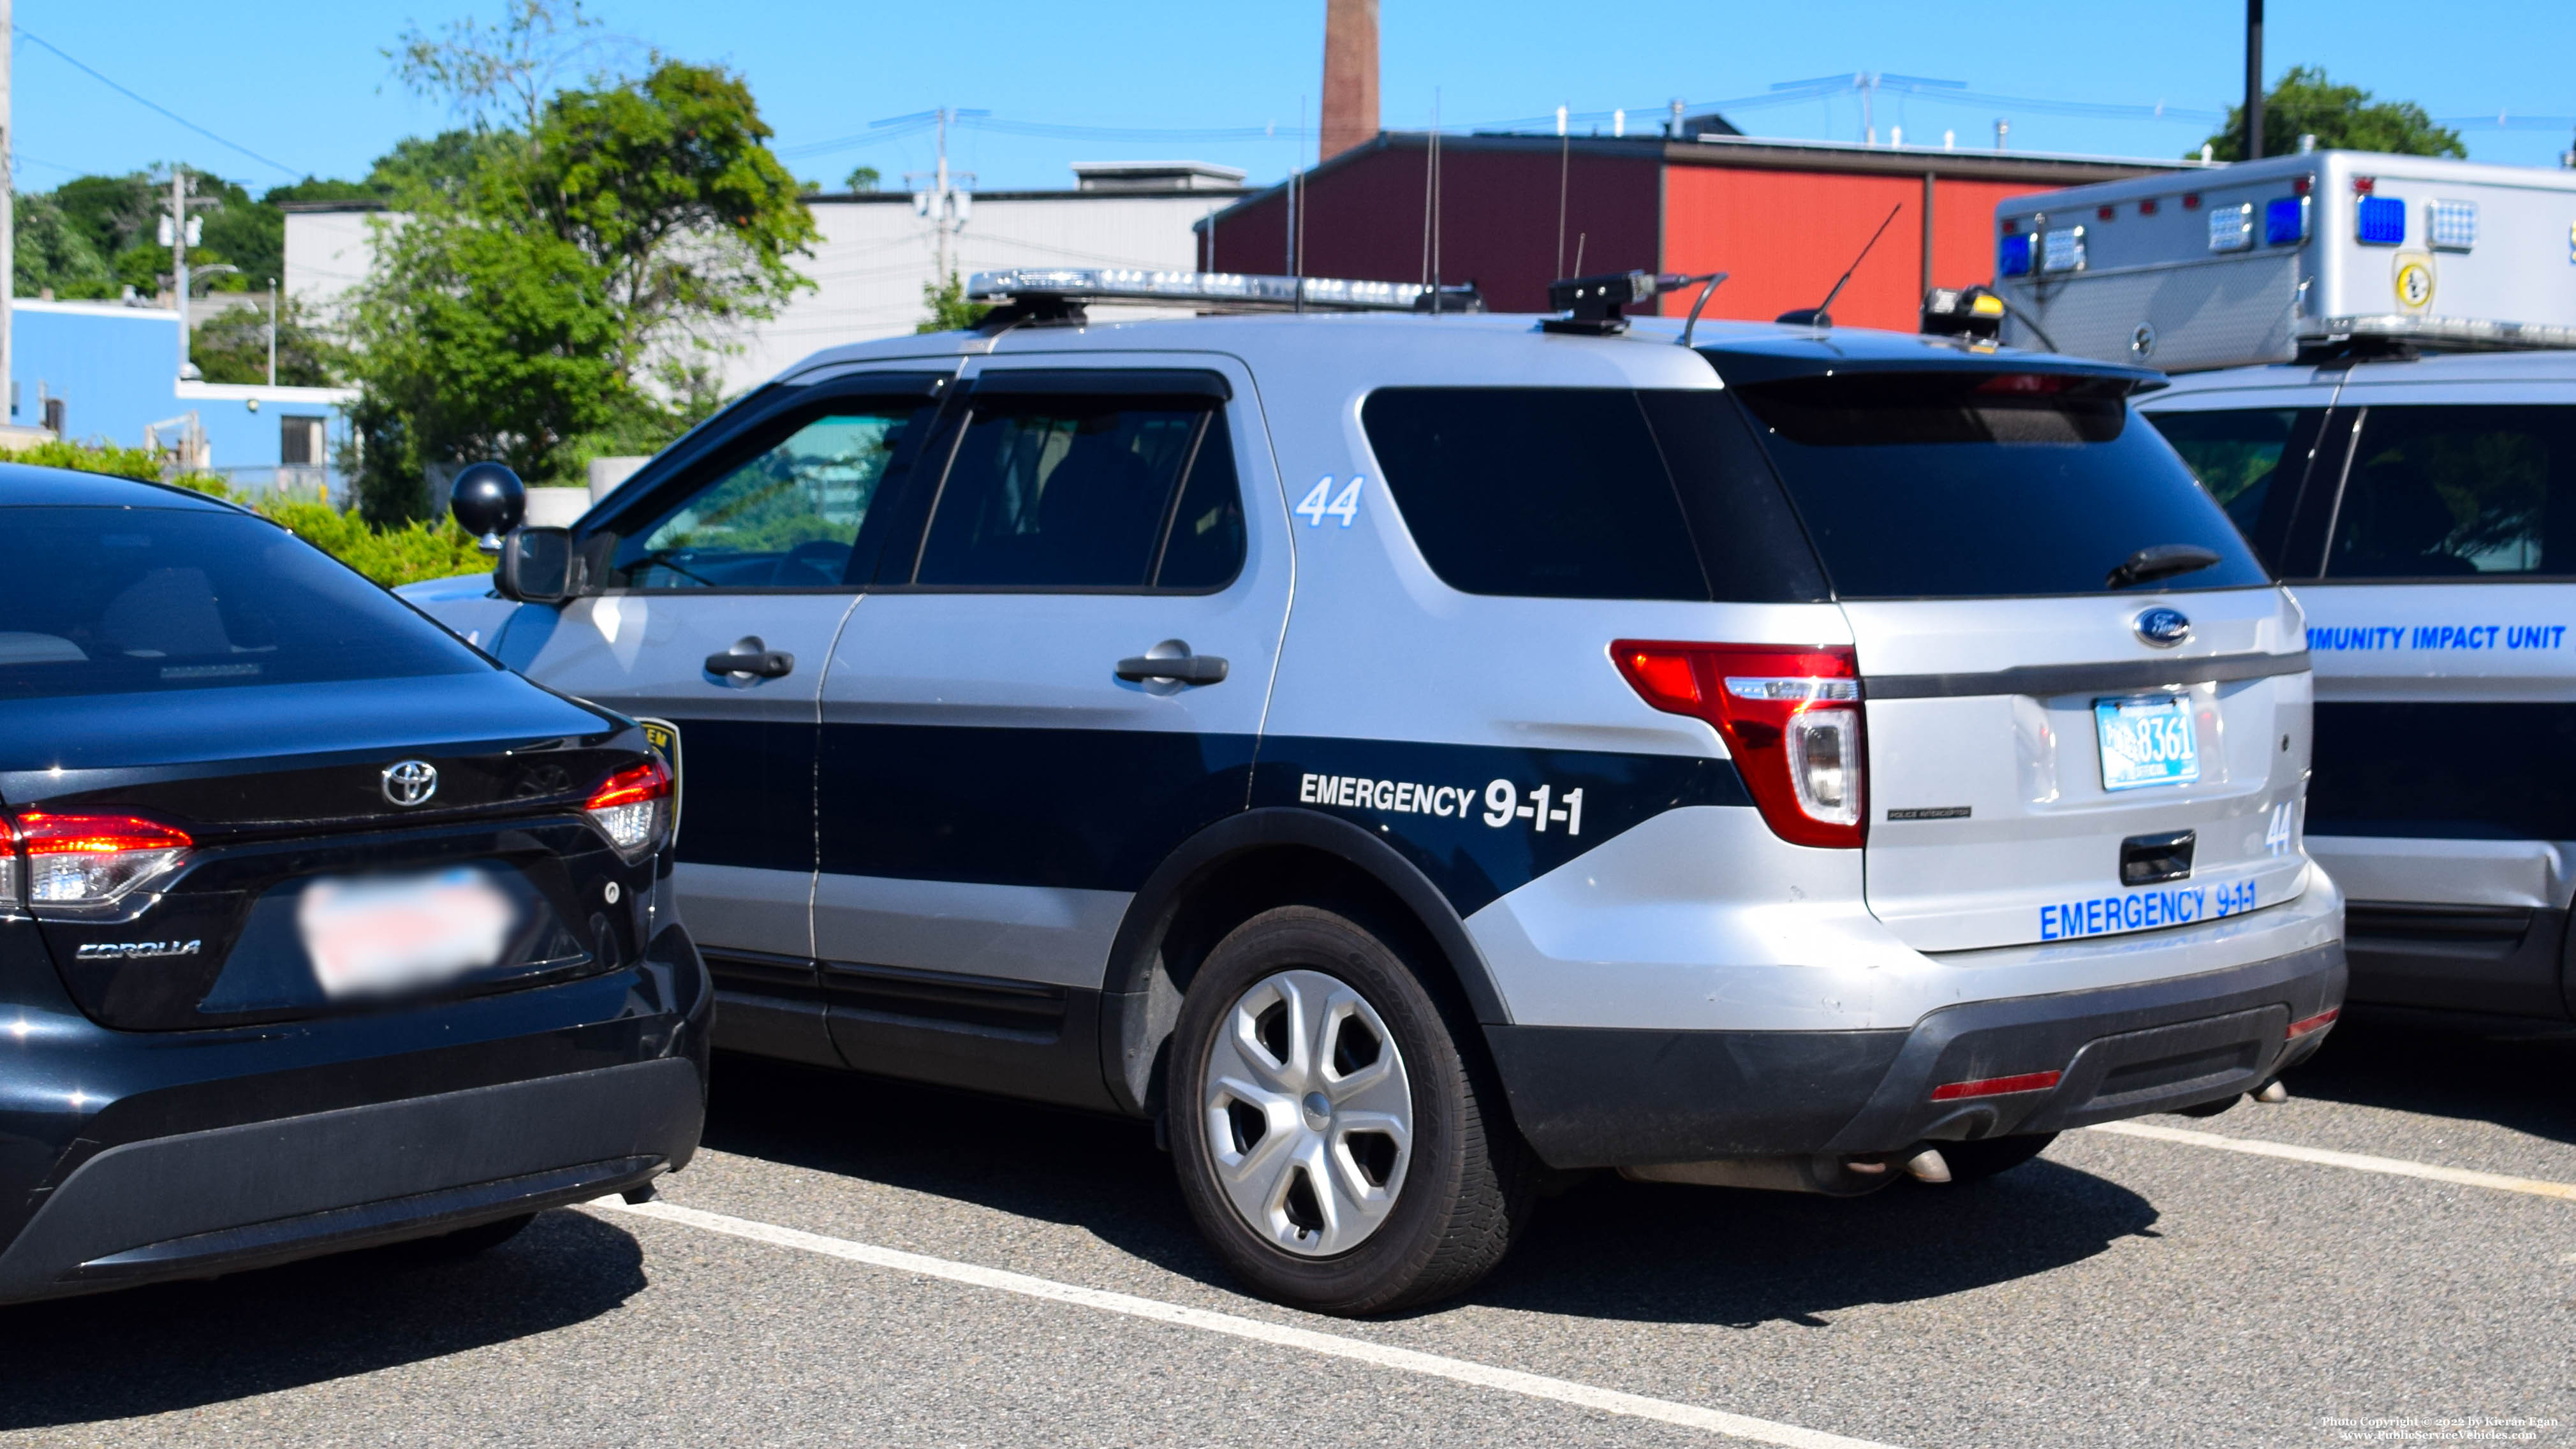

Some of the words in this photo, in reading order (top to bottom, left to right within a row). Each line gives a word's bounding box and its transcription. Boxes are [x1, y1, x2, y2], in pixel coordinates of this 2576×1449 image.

[1293, 474, 1366, 529] 44
[2412, 626, 2499, 649] IMPACT
[2506, 626, 2566, 649] UNIT
[2137, 716, 2195, 762] 8361
[1300, 773, 1476, 818] EMERGENCY
[1483, 779, 1584, 835] 9-1-1
[2265, 798, 2293, 857] 44
[2040, 886, 2205, 941] EMERGENCY
[2216, 879, 2256, 918] 9-1-1
[75, 939, 201, 959] COROLLA
